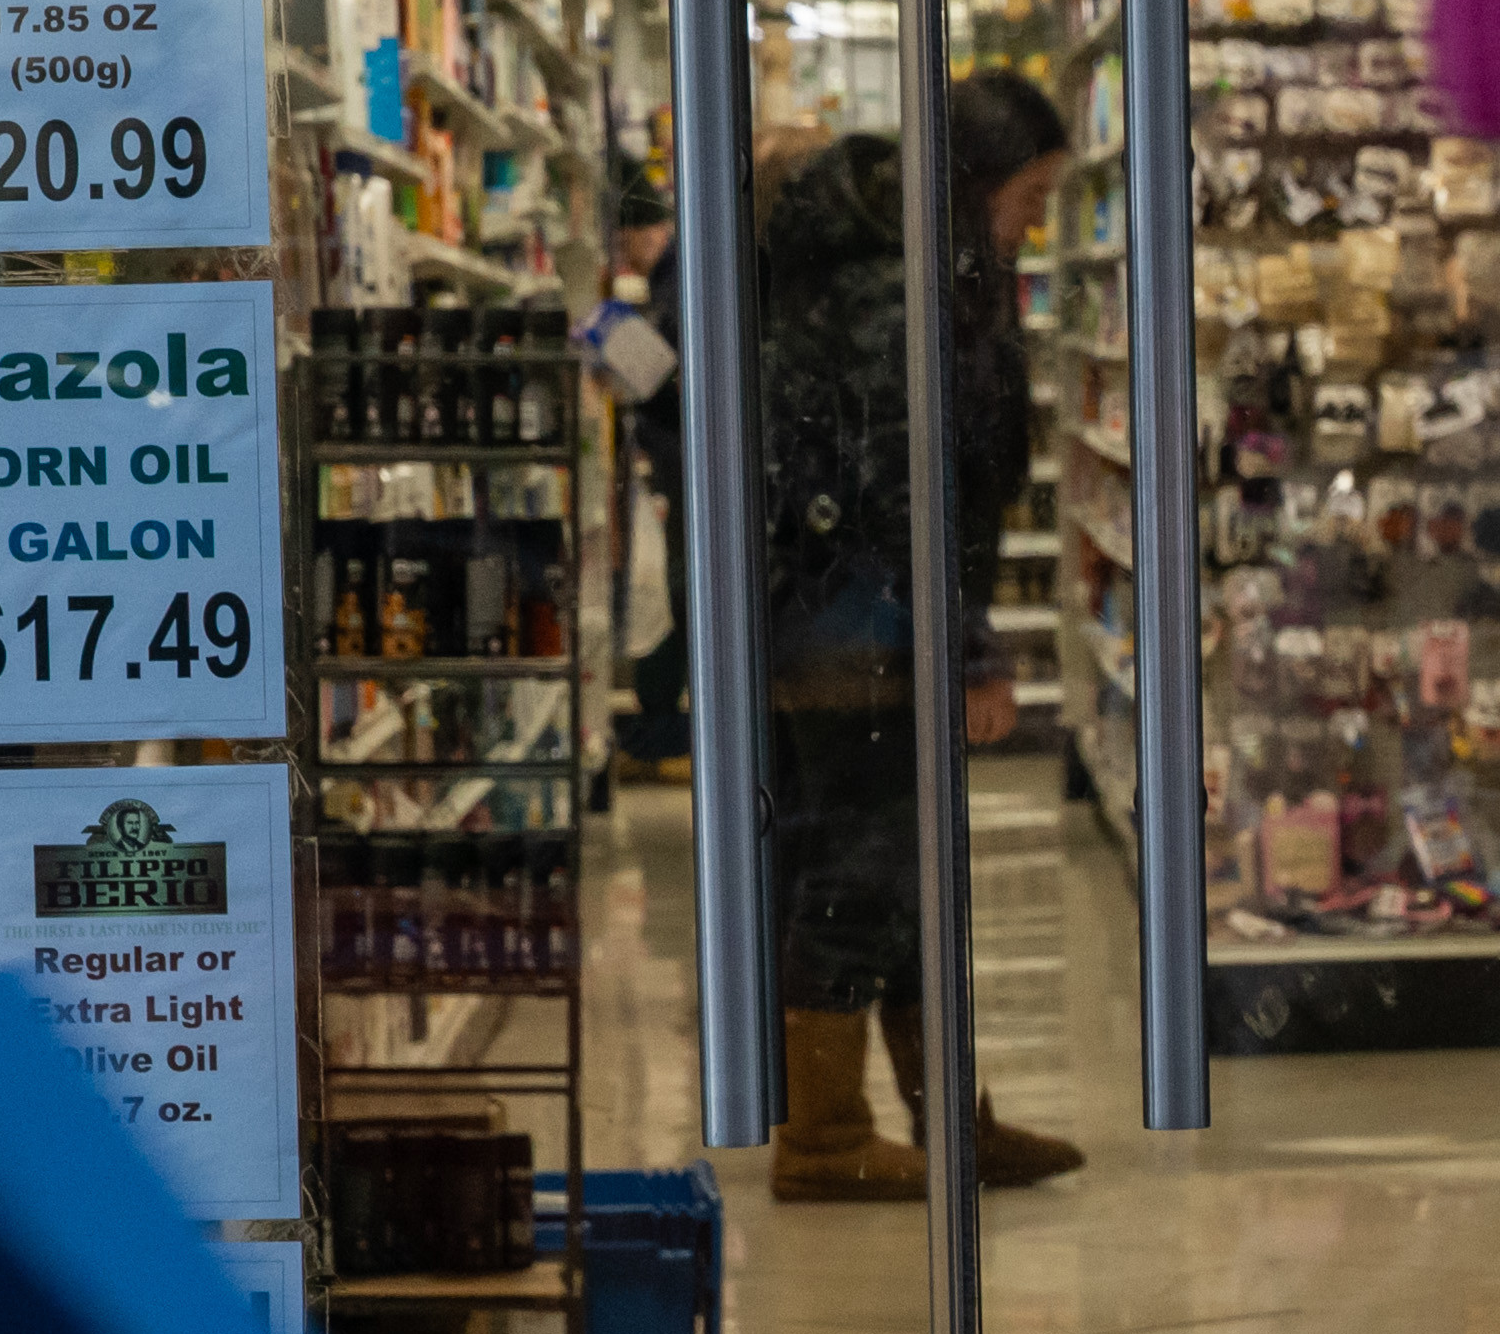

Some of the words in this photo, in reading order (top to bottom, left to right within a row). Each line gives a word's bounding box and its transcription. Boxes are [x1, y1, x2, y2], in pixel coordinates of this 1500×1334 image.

[103, 5, 158, 32] OZ
[11, 55, 133, 91] (500g)
[130, 445, 228, 484] OIL
[8, 520, 215, 562] GALON
[56, 858, 208, 878] FILIPPO
[44, 880, 218, 907] BERIO
[34, 947, 185, 980] Regular
[196, 949, 236, 970] or
